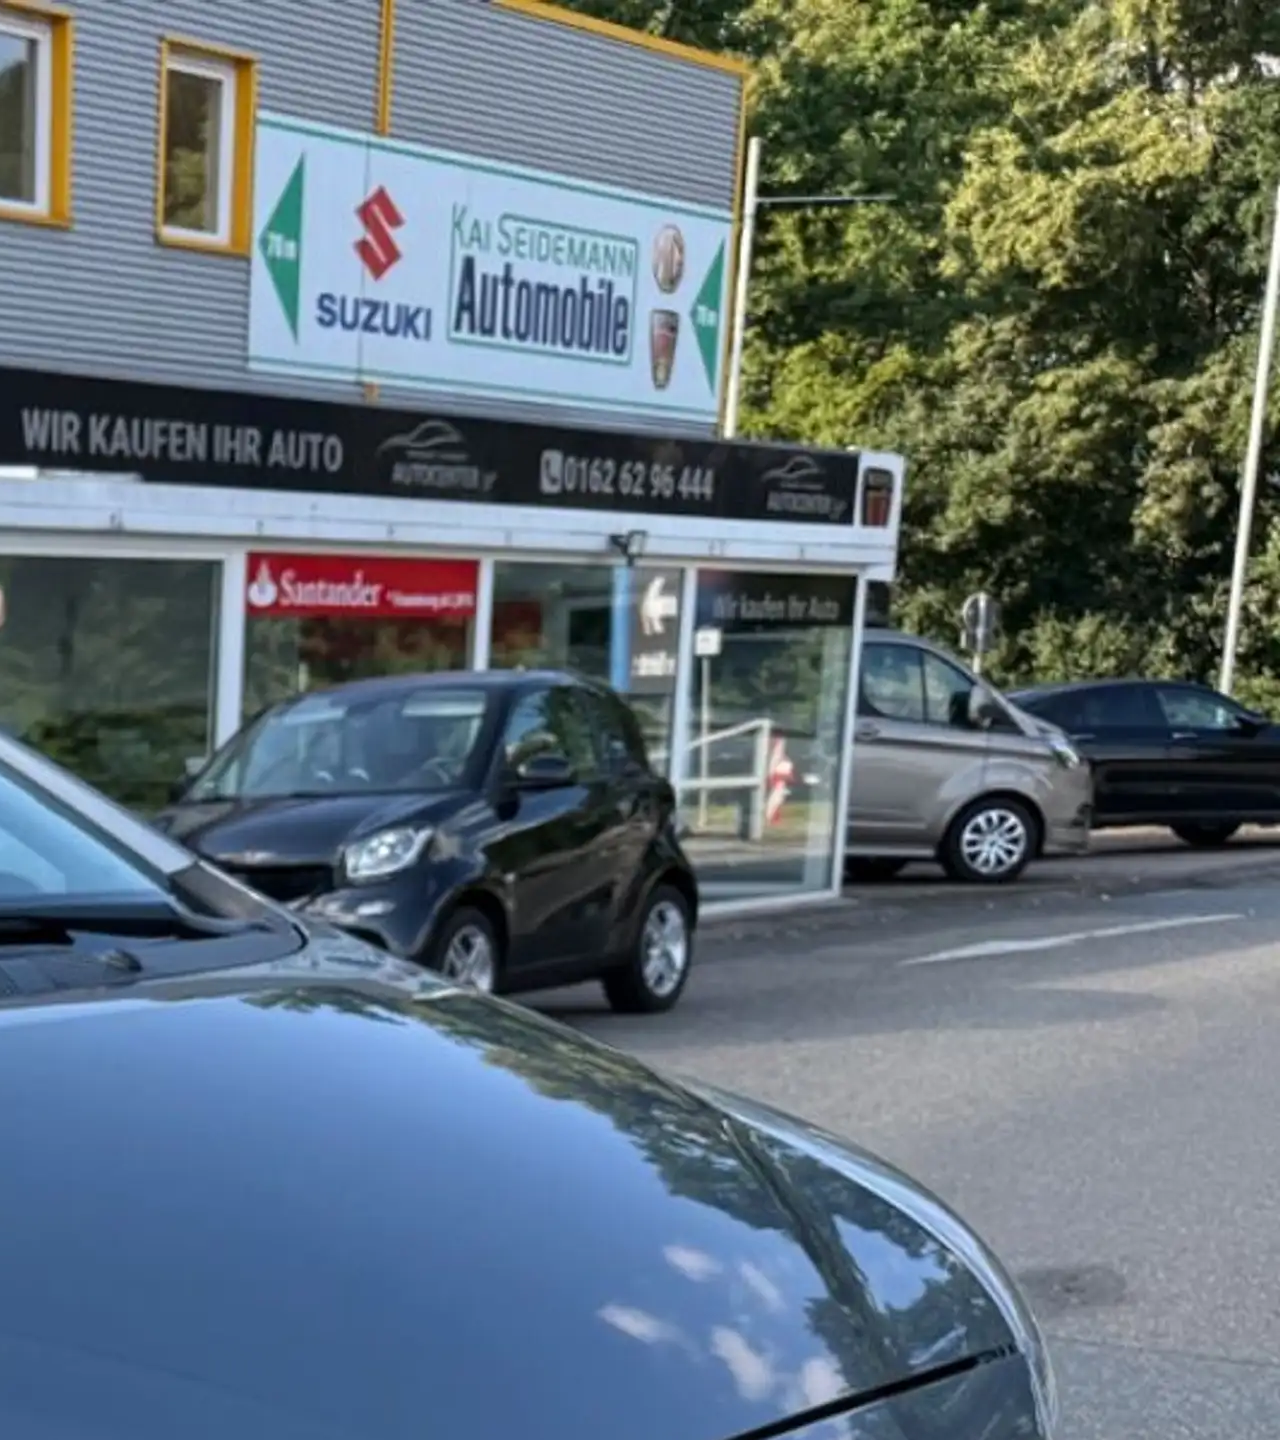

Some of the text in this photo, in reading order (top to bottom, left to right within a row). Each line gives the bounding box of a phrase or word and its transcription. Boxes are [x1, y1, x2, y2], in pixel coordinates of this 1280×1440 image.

[315, 292, 432, 341] SUZUKI
[453, 256, 630, 356] Automobile
[21, 408, 343, 473] WIR KAUFEN IHR AUTO
[564, 456, 615, 494] 0162
[619, 460, 646, 496] 62
[678, 464, 715, 501] 444
[278, 568, 382, 607] Santander
